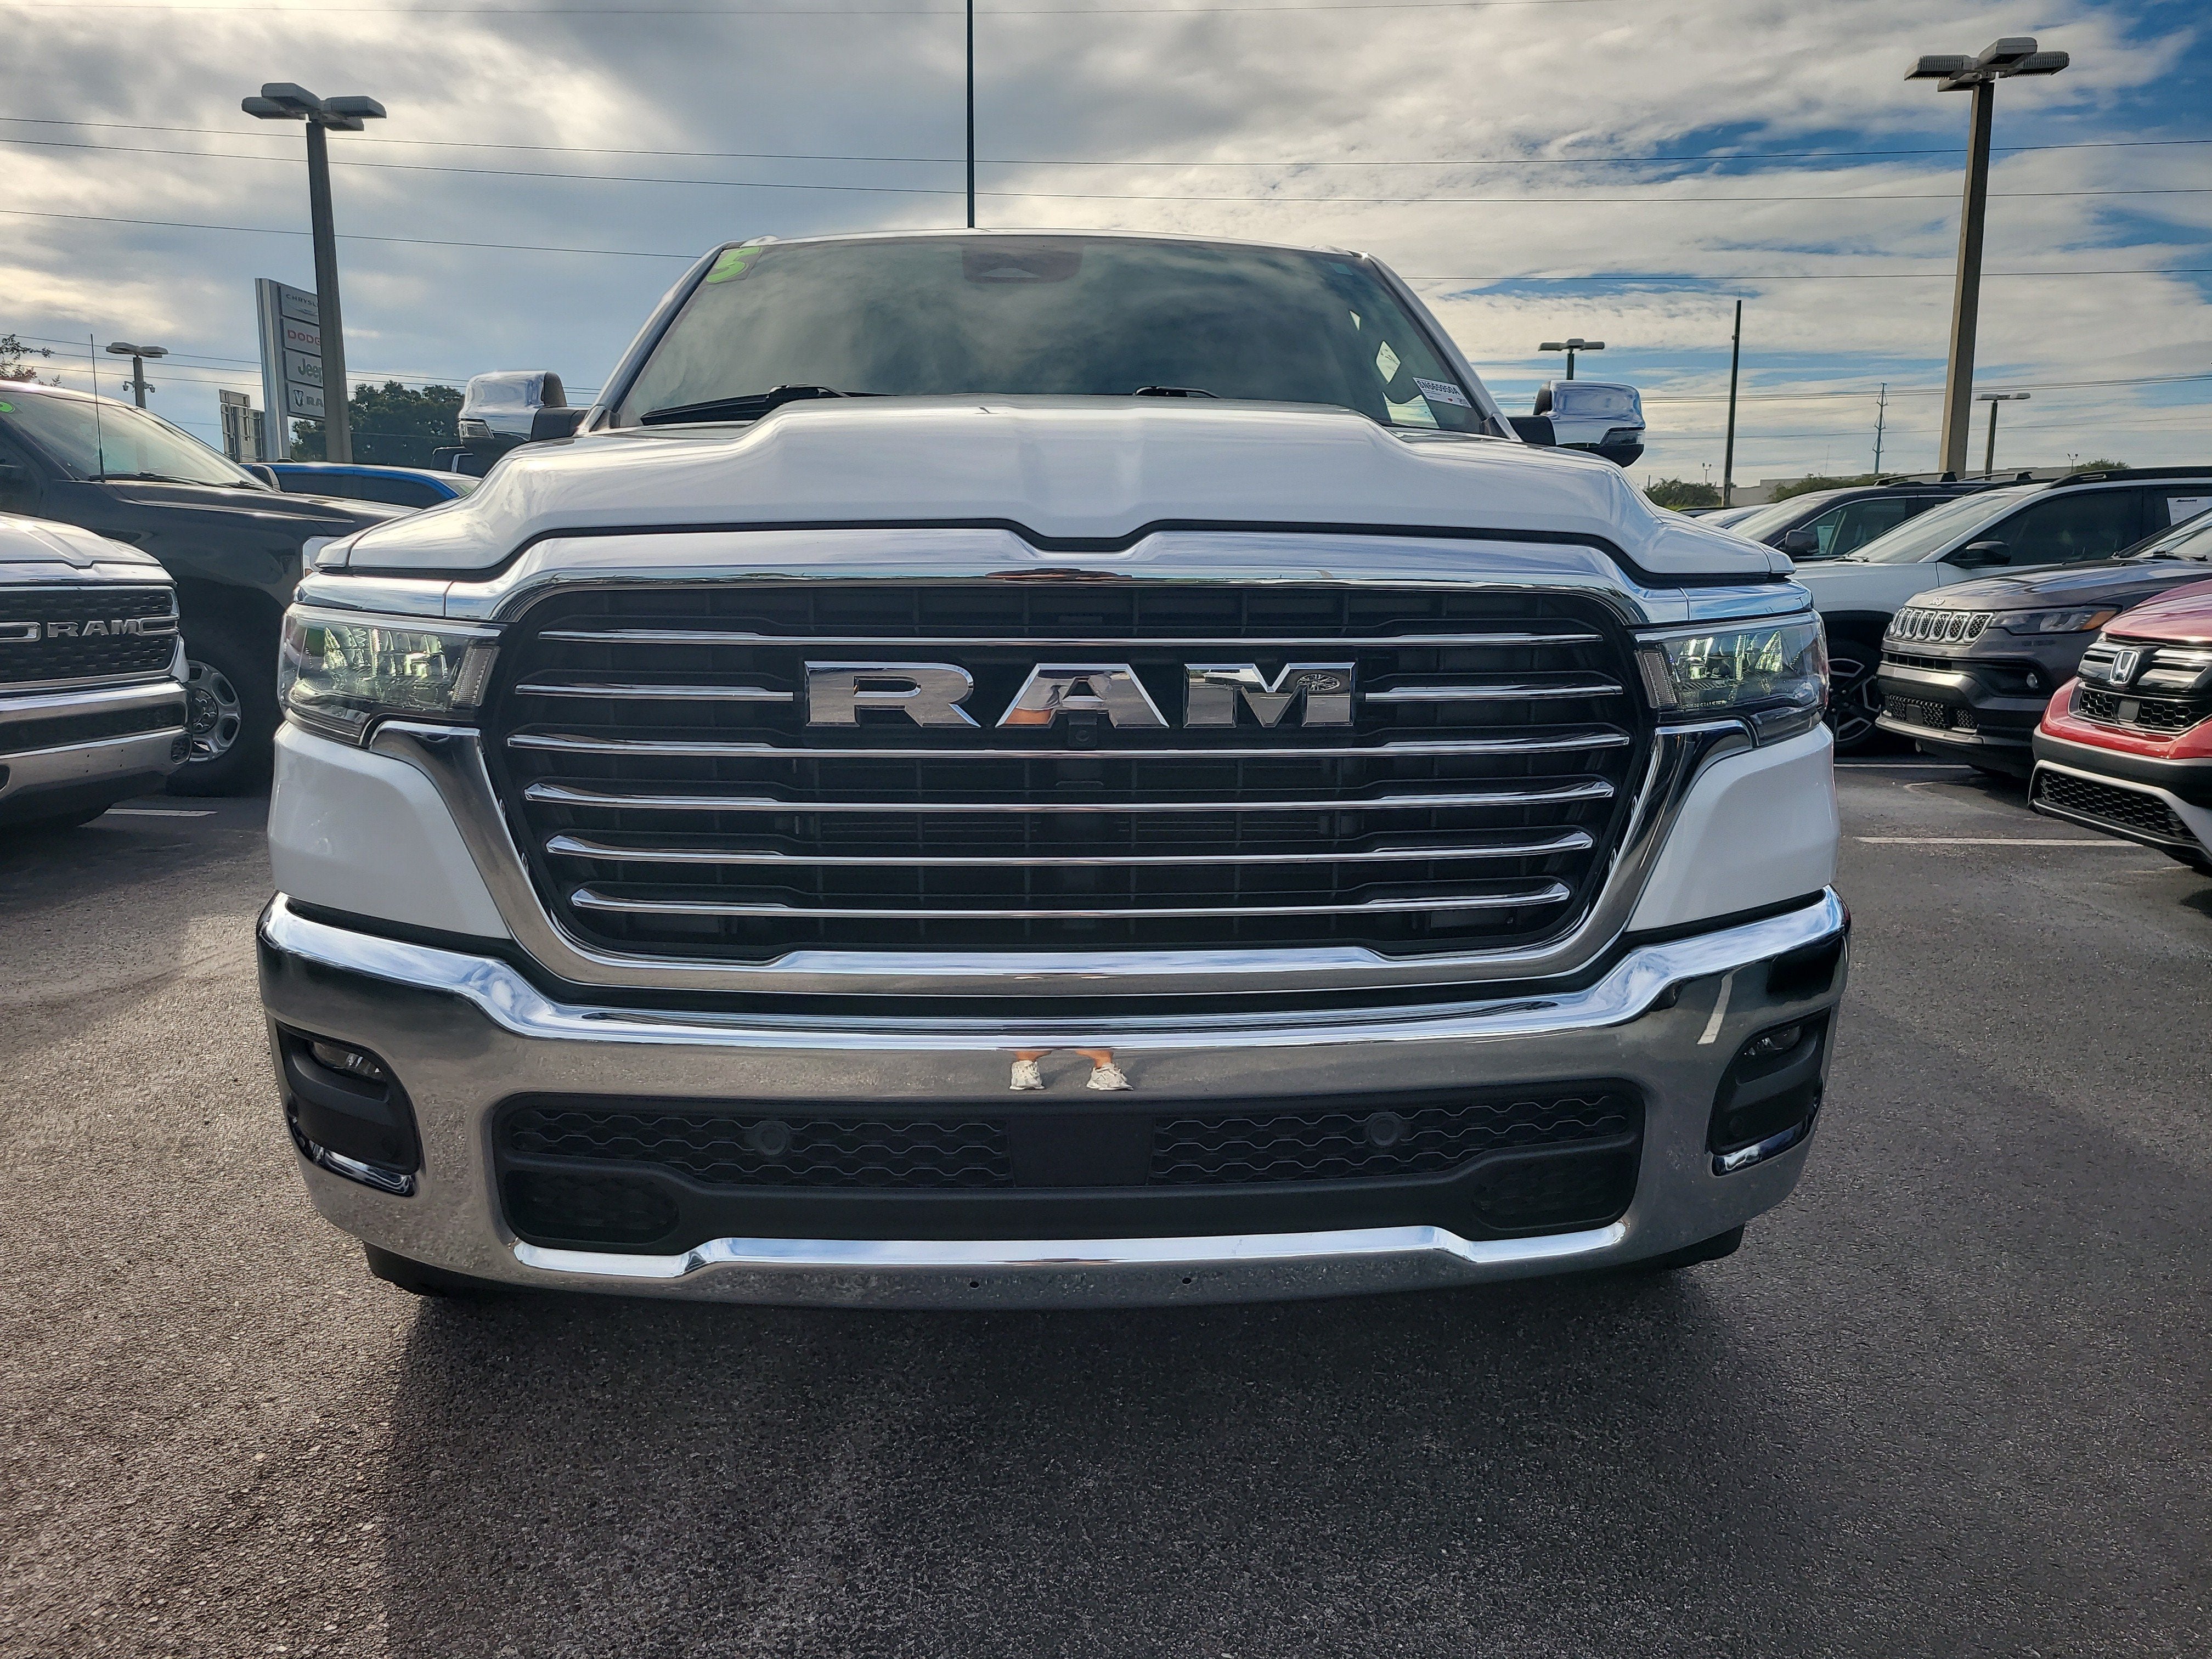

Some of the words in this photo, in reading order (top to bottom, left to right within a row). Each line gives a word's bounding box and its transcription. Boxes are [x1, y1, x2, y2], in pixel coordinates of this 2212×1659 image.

[706, 246, 760, 283] 5
[286, 294, 317, 307] CHRYSL
[287, 329, 320, 345] DODG
[306, 396, 324, 408] RA
[47, 619, 138, 637] RAM
[804, 661, 1357, 729] RAM
